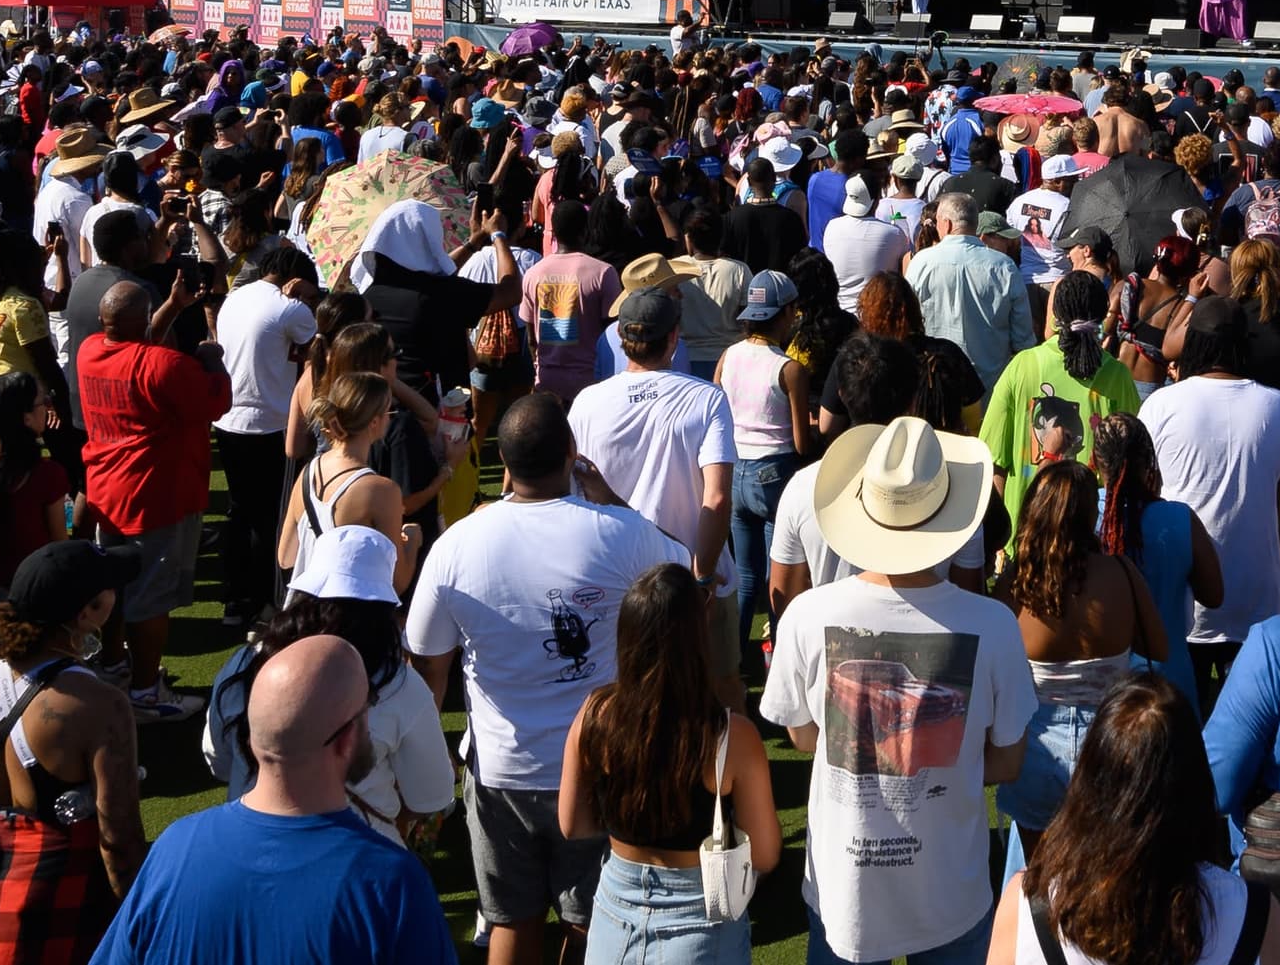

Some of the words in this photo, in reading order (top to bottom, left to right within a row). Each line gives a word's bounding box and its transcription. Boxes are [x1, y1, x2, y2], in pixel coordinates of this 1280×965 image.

[227, 0, 250, 10] STAGE
[285, 2, 309, 13] STAGE
[347, 5, 375, 17] STAGE
[413, 8, 442, 21] STAGE
[628, 390, 659, 404] TEXAS
[851, 835, 861, 846] In
[862, 837, 878, 847] ten
[864, 846, 912, 857] resistance
